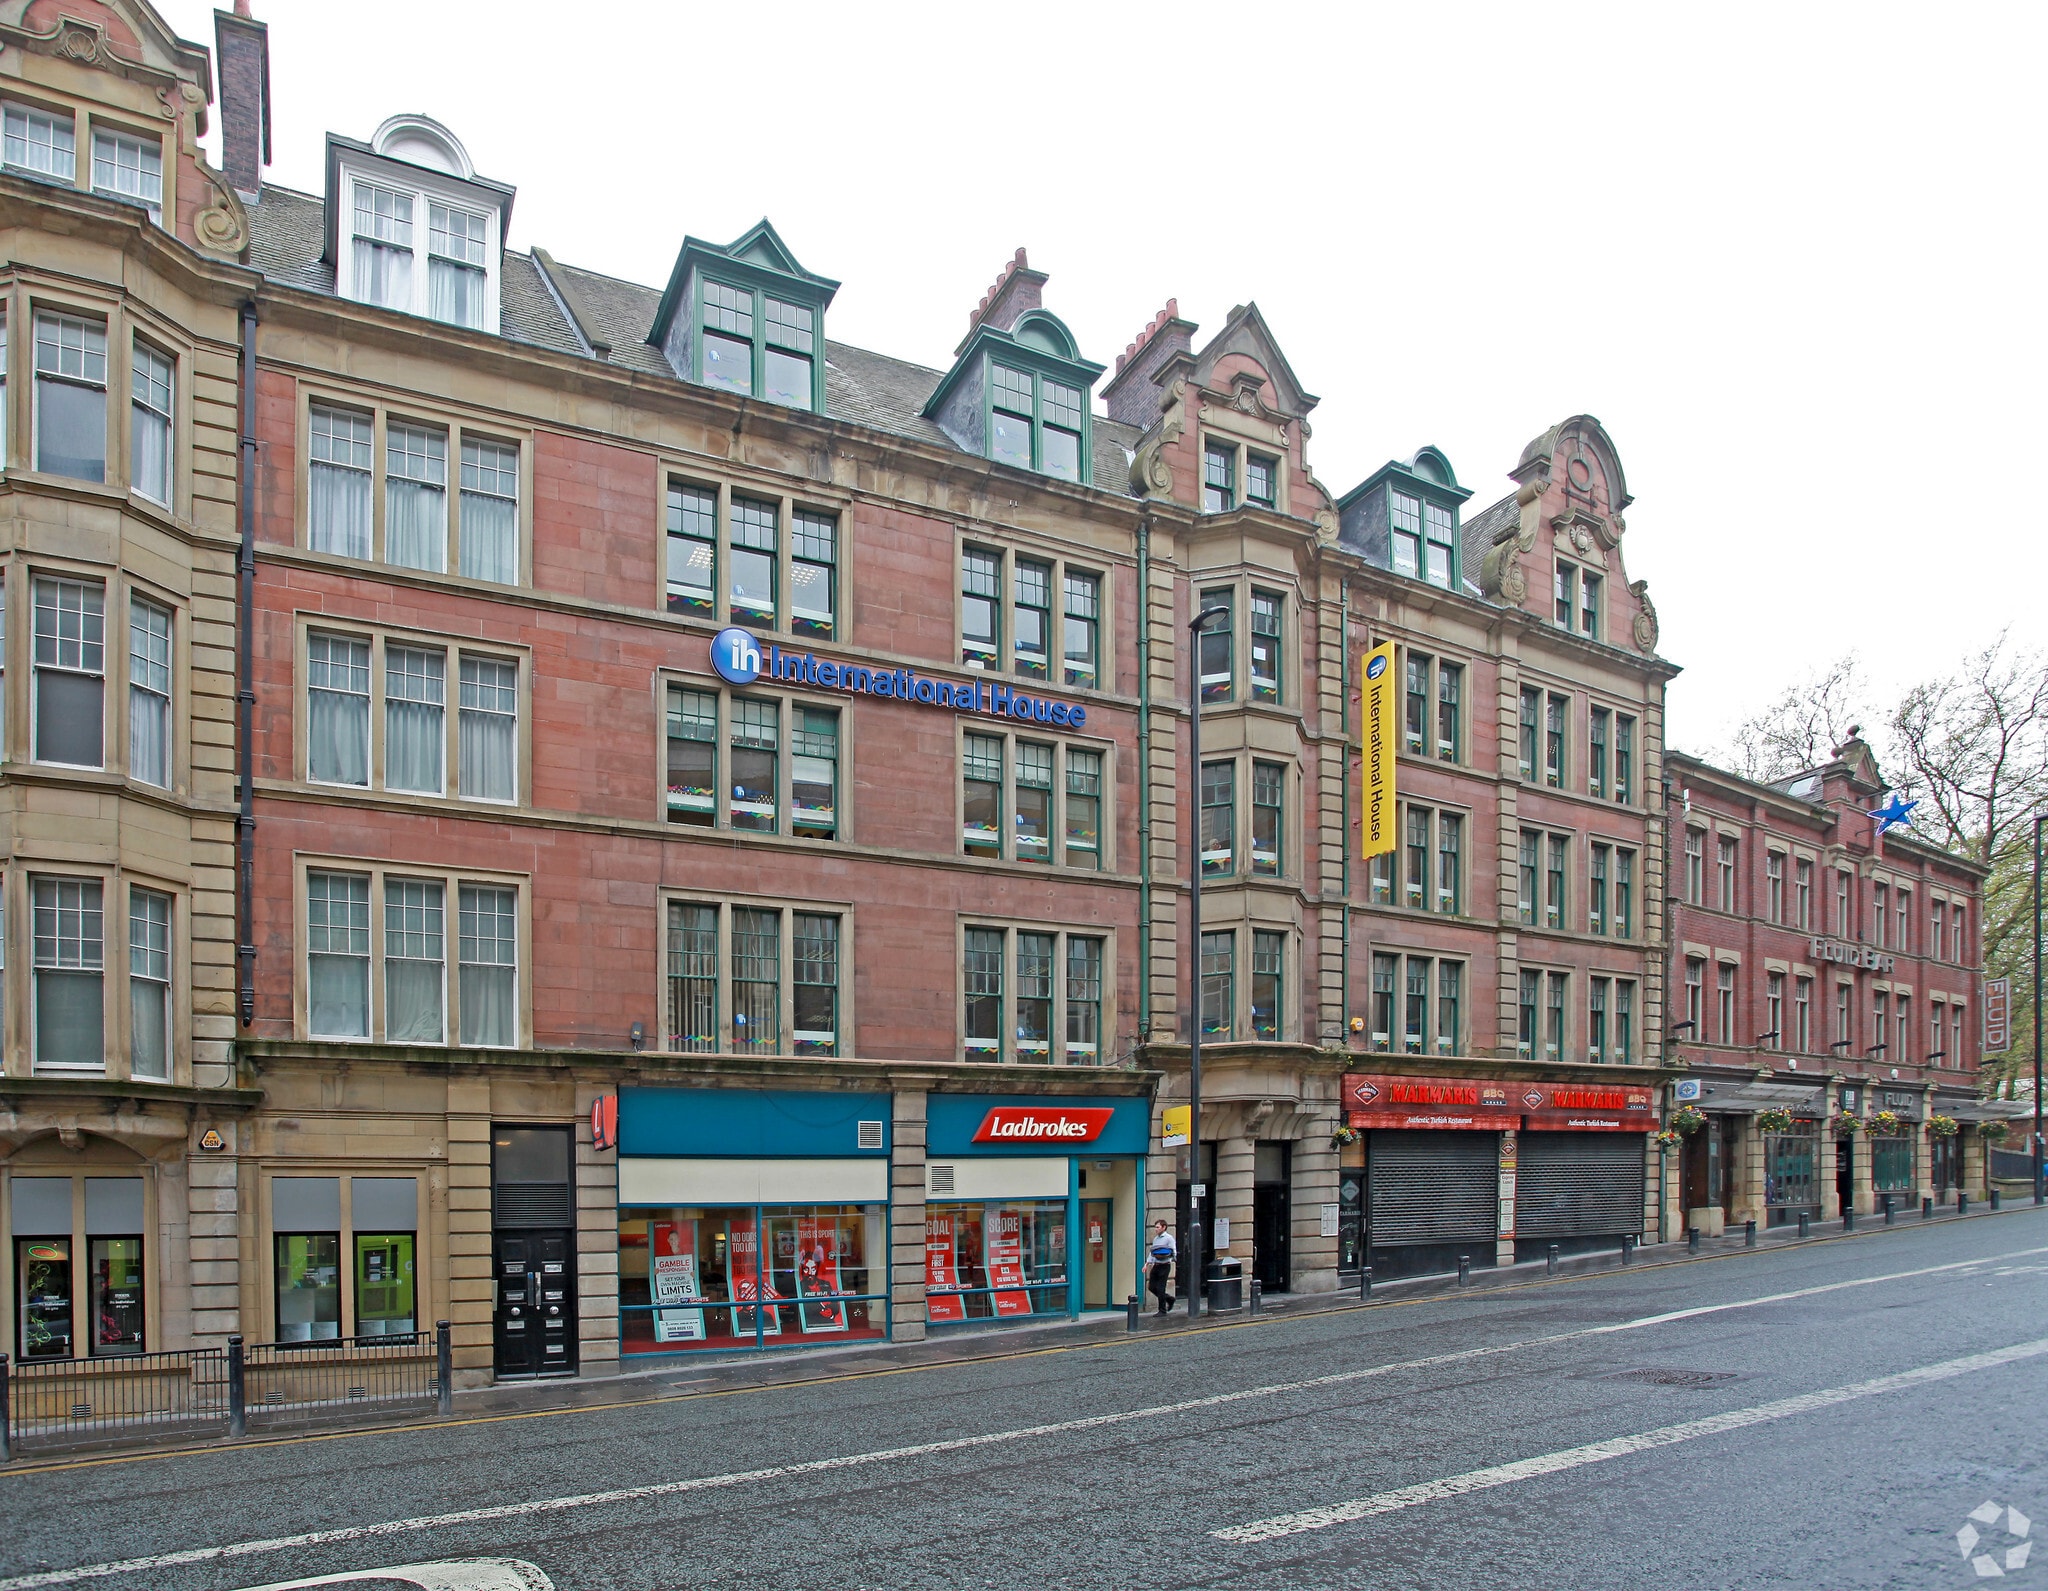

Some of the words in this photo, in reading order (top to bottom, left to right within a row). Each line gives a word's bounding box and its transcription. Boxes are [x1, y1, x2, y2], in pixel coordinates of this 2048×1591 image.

[1370, 660, 1380, 679] ih
[732, 638, 760, 674] ih
[770, 645, 983, 712] International
[990, 683, 1087, 729] House
[1370, 684, 1383, 787] International
[1370, 789, 1383, 842] House
[1810, 936, 1859, 966] FLUID
[1861, 945, 1894, 973] BAR
[1988, 982, 2004, 1044] FLUID
[1389, 1084, 1477, 1105] MARMARIS
[1483, 1088, 1505, 1099] BBQ
[1551, 1091, 1624, 1109] MARMARIS
[1628, 1094, 1647, 1104] BBQ
[1884, 1092, 1913, 1106] FLUID
[595, 1103, 600, 1133] L
[990, 1116, 1088, 1137] Ladbrokes
[1407, 1116, 1430, 1124] Authentic
[1431, 1116, 1447, 1124] Turkish
[800, 1230, 811, 1238] THIS
[818, 1229, 835, 1238] SPORT
[926, 1219, 950, 1235] GOAL
[989, 1217, 1018, 1233] SCORE
[731, 1232, 741, 1242] NO
[731, 1242, 745, 1252] TOO
[659, 1259, 690, 1268] GAMBLE
[661, 1285, 692, 1295] LIMITS
